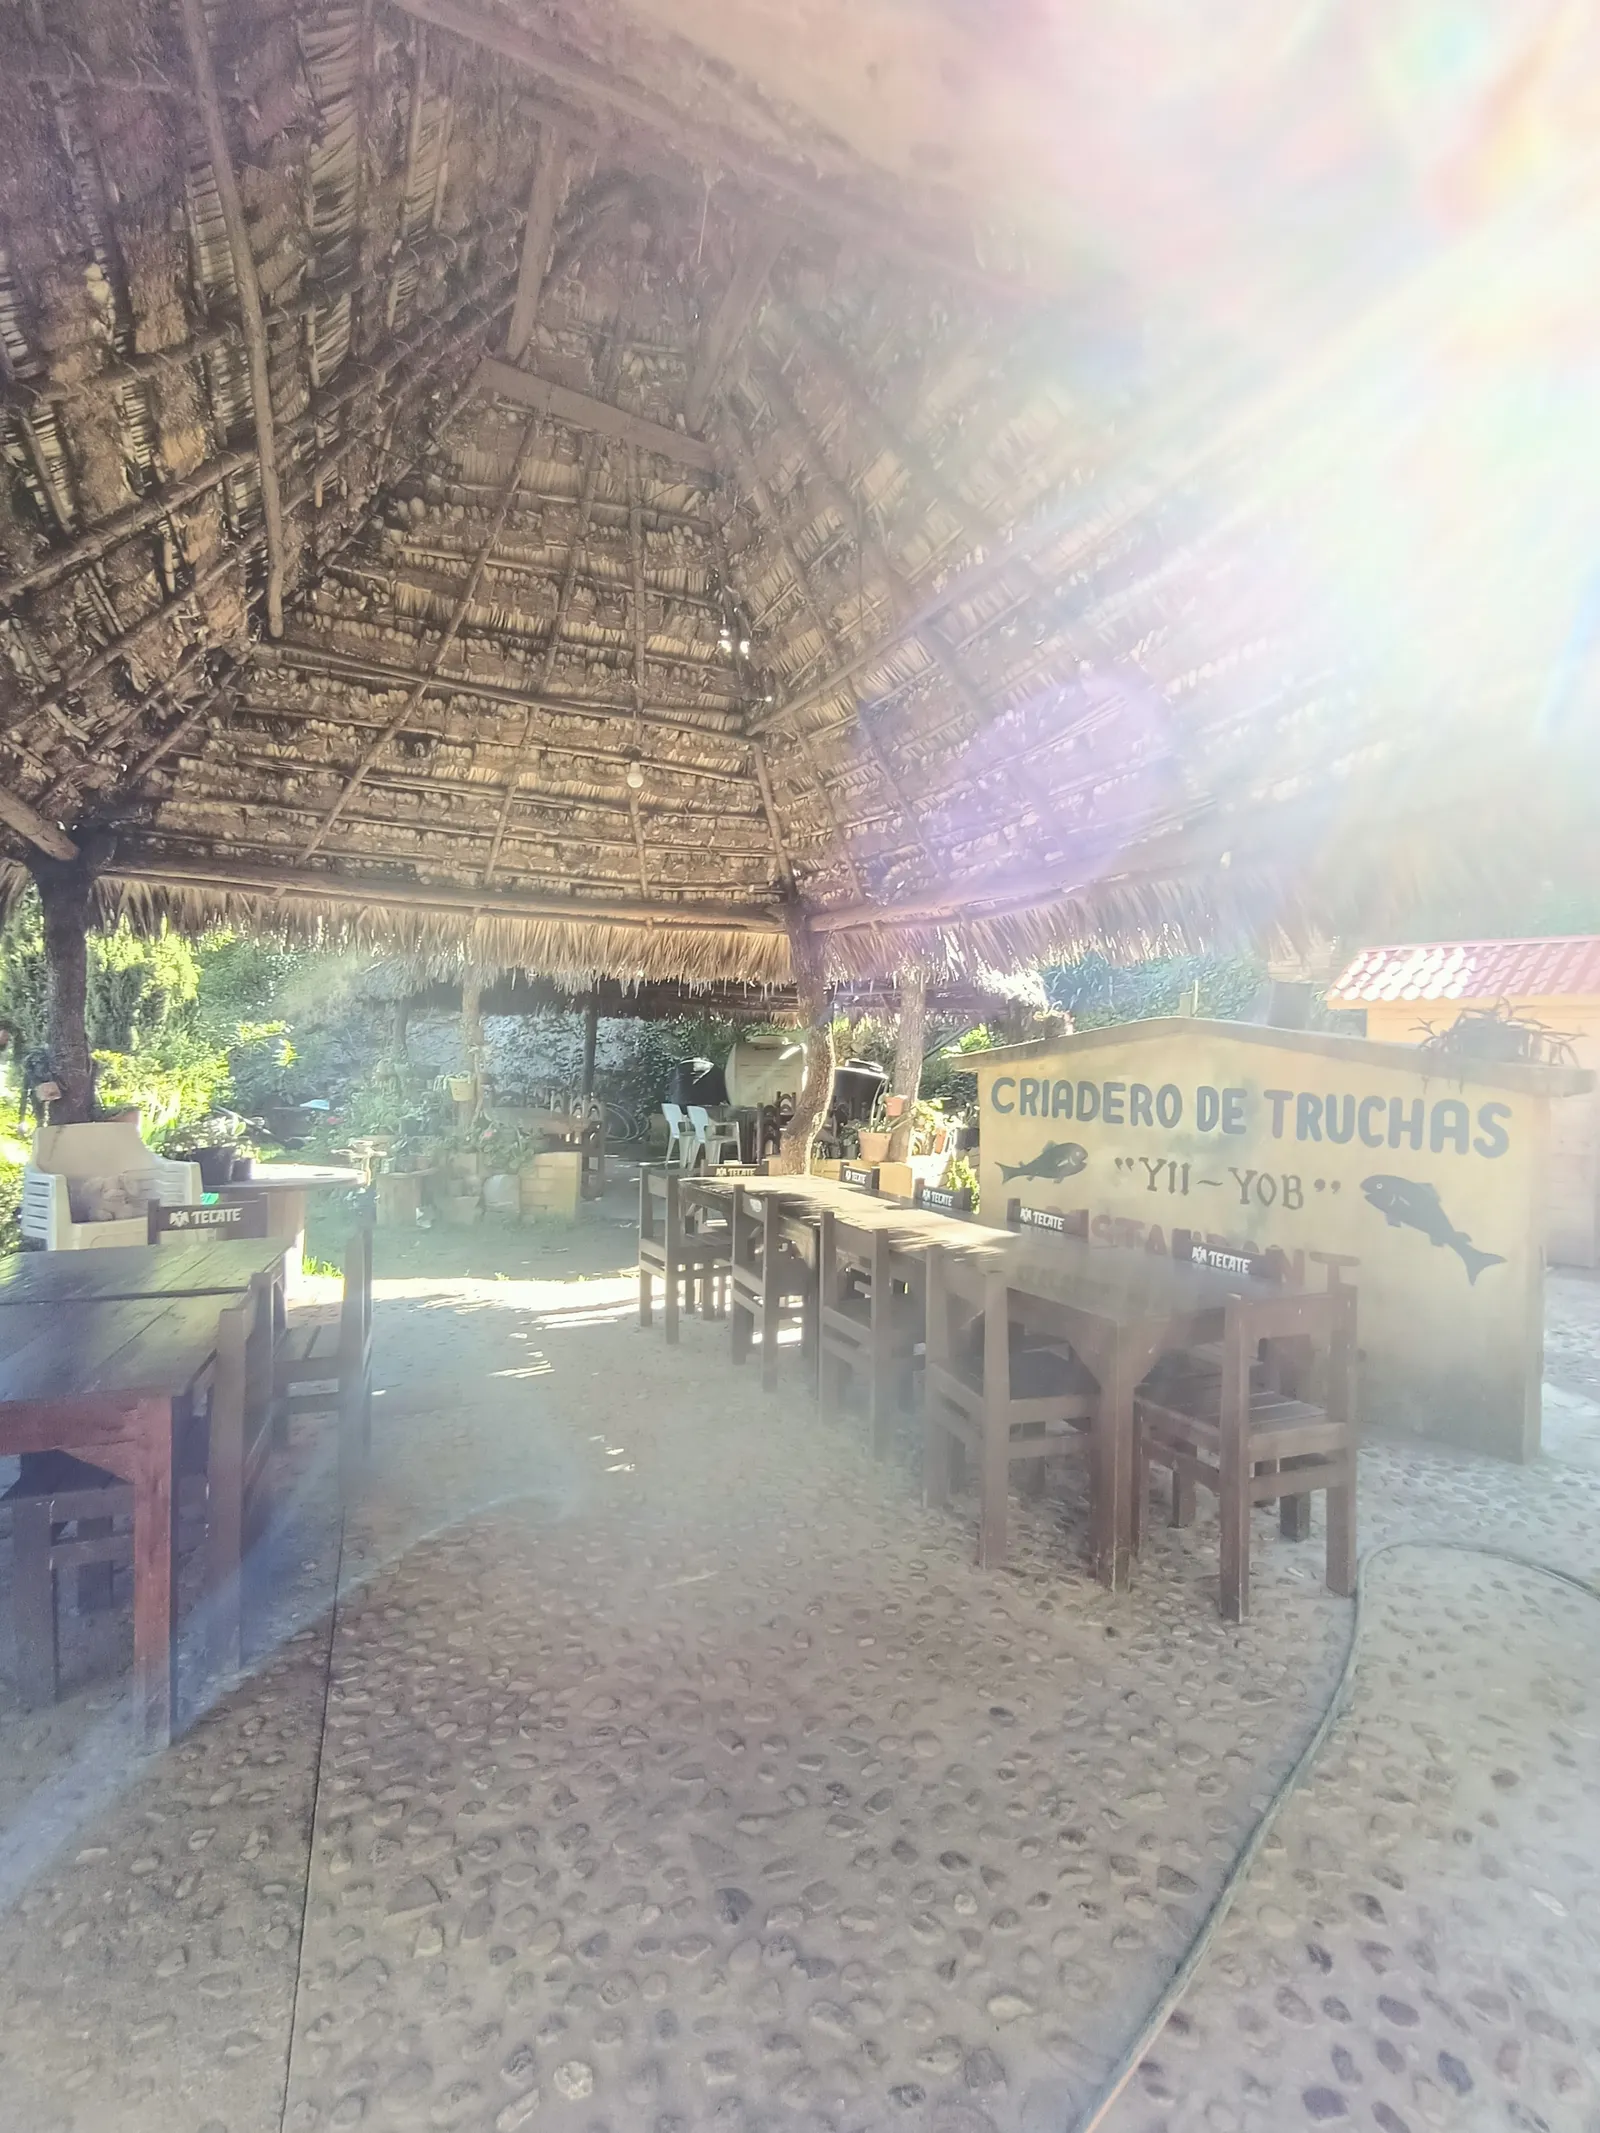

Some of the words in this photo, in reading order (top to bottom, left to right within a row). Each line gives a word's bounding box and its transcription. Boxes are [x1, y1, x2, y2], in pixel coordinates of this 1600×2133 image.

[991, 1077, 1183, 1129] CRIADERO
[1196, 1086, 1248, 1135] DE
[1263, 1089, 1512, 1160] TRUCHAS
[931, 1191, 954, 1207] TECATE
[191, 1207, 243, 1225] TECATE
[1032, 1211, 1065, 1231] TECATE
[1208, 1251, 1252, 1274] TECATE
